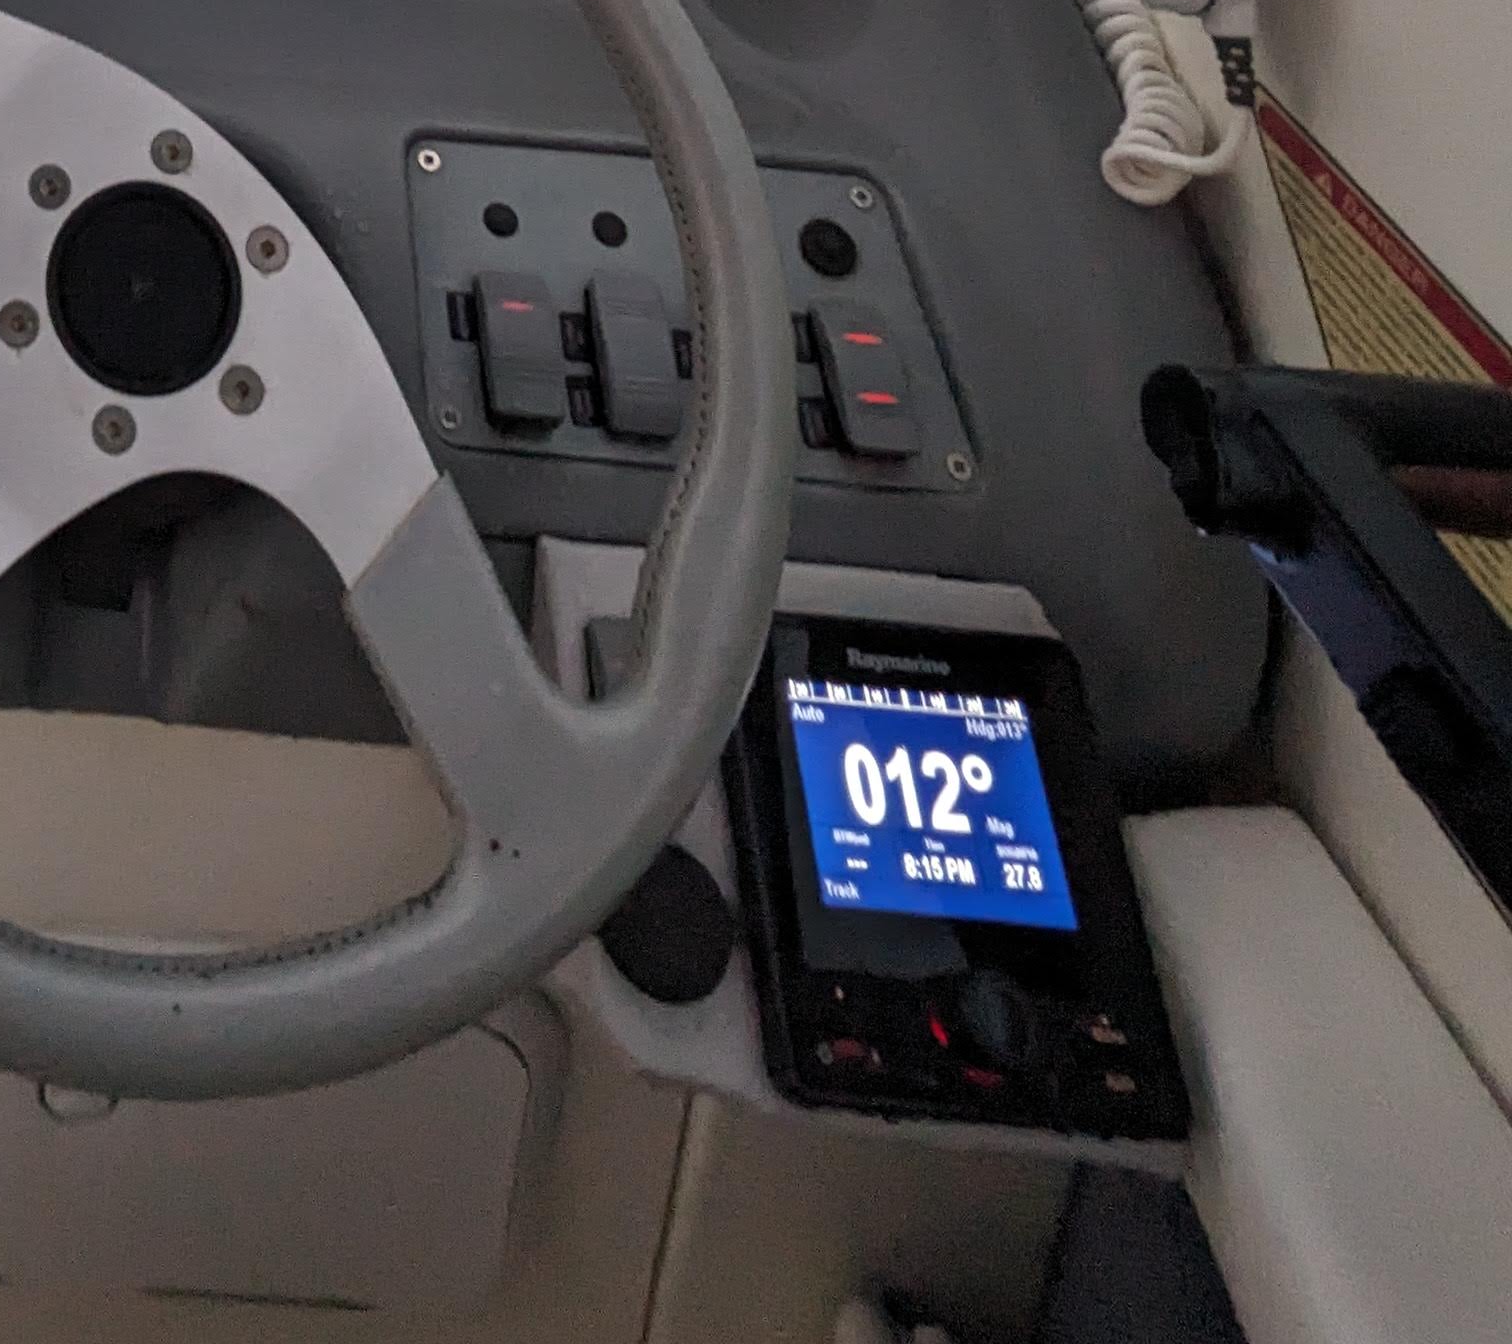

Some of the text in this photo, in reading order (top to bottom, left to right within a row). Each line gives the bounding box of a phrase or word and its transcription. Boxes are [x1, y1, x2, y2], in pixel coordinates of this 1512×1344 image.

[846, 646, 952, 676] Raymarine
[792, 702, 825, 723] Auto
[844, 743, 993, 833] 012°
[946, 859, 976, 885] PM
[1003, 863, 1043, 891] 27.8
[824, 878, 860, 899] Track
